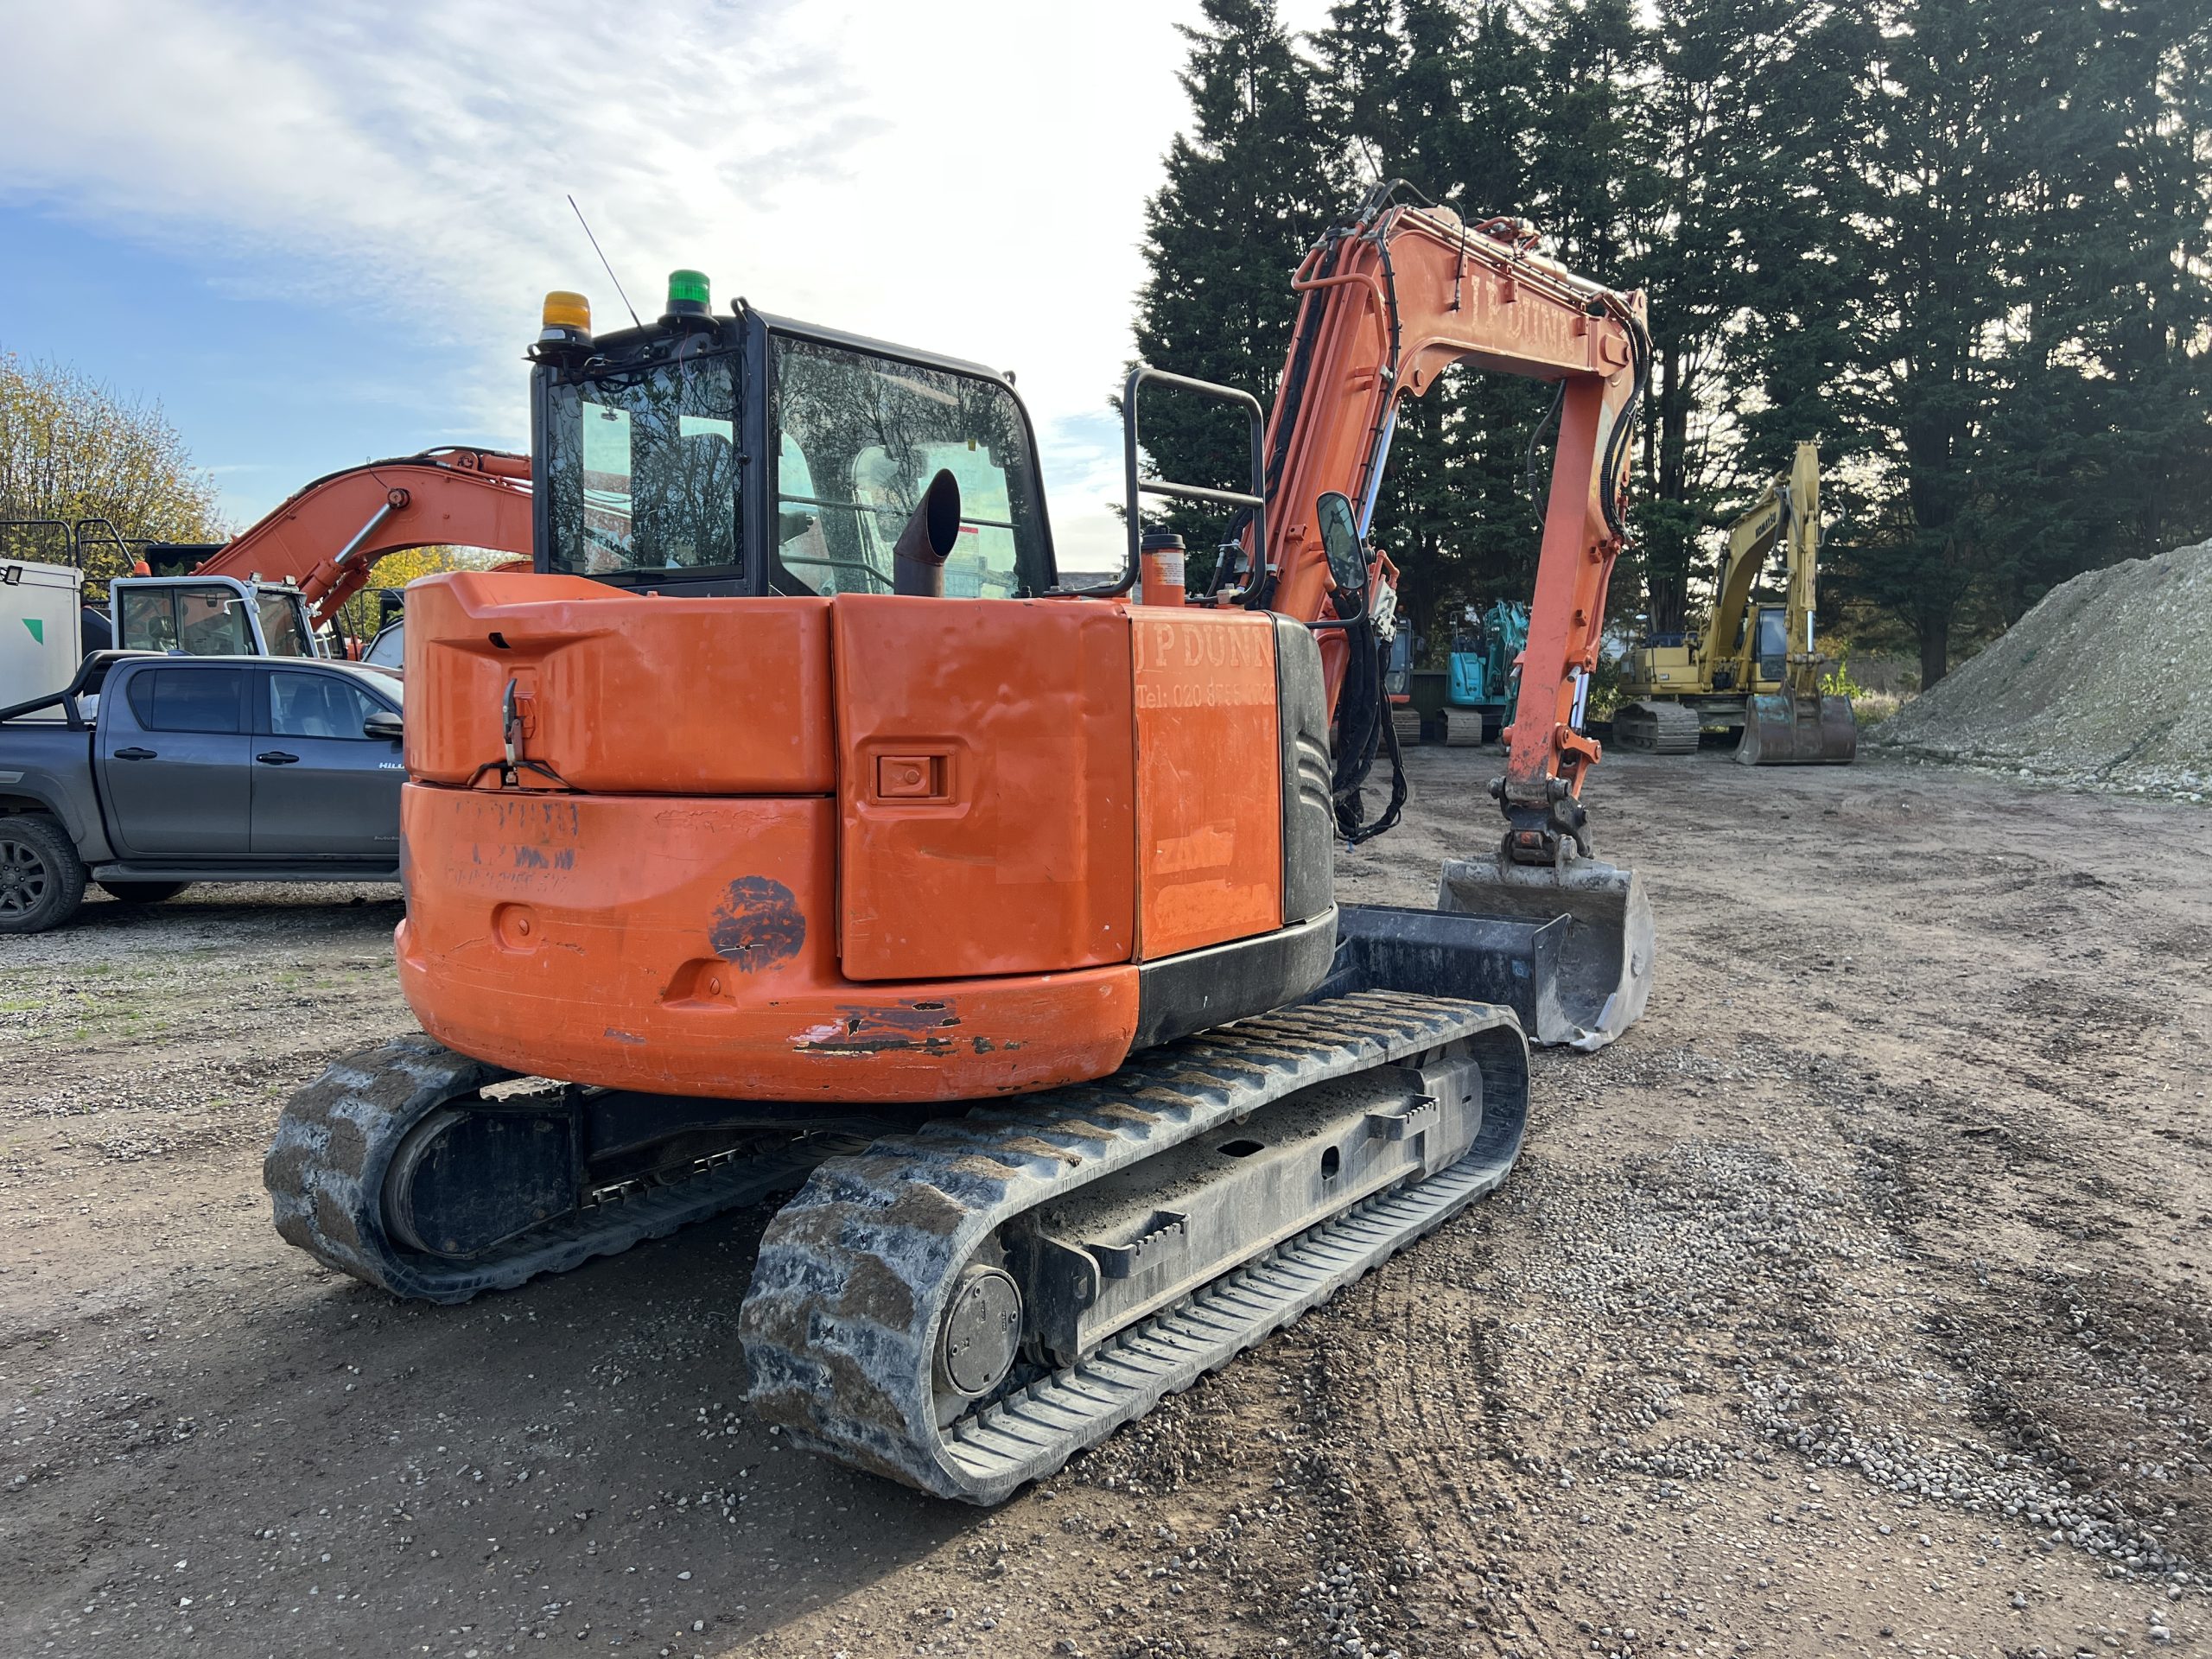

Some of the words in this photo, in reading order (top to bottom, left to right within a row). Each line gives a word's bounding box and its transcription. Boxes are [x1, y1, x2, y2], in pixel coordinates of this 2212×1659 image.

[1485, 278, 1502, 332] P
[1506, 296, 1575, 359] DUNN
[1134, 621, 1145, 674] J
[1154, 622, 1175, 667] P
[1181, 623, 1274, 668] DUNN
[1135, 684, 1168, 709] Tel:
[1173, 683, 1202, 707] 020
